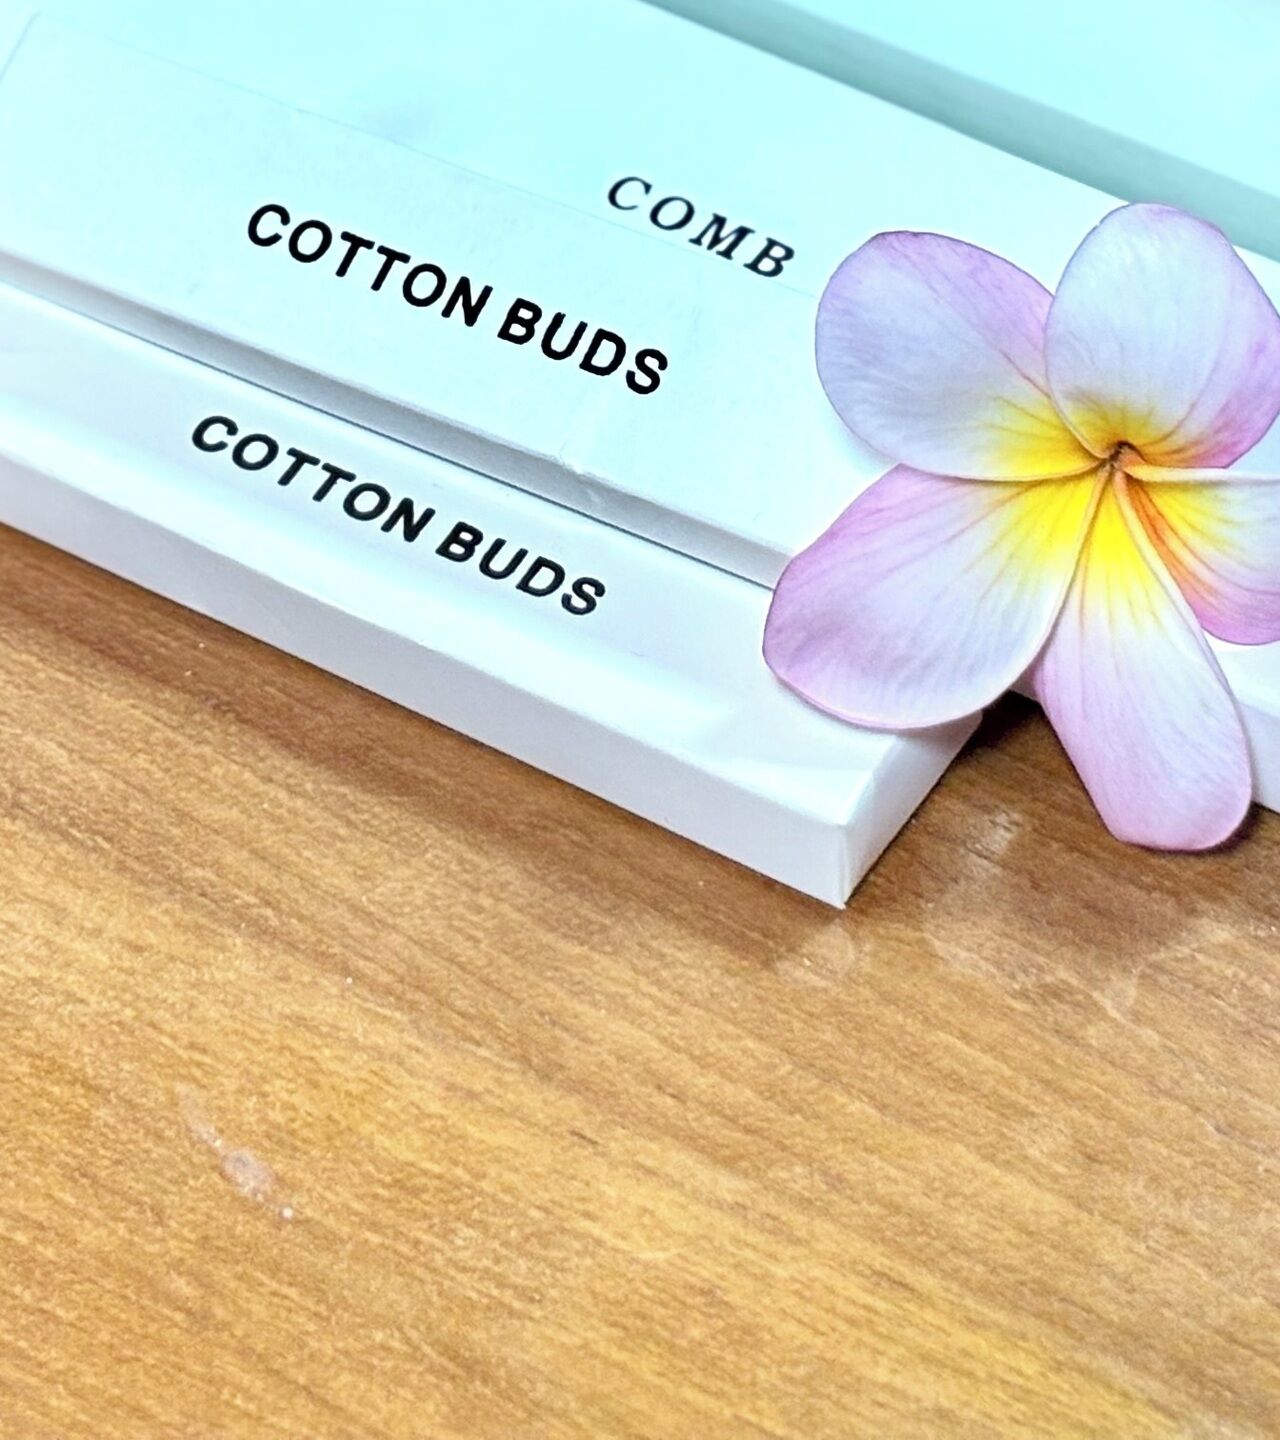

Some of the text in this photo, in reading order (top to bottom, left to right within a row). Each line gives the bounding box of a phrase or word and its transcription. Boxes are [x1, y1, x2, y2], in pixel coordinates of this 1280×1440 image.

[247, 204, 669, 394] COTTON BUDS
[607, 176, 795, 278] COMB
[192, 416, 605, 615] COTTON BUDS
